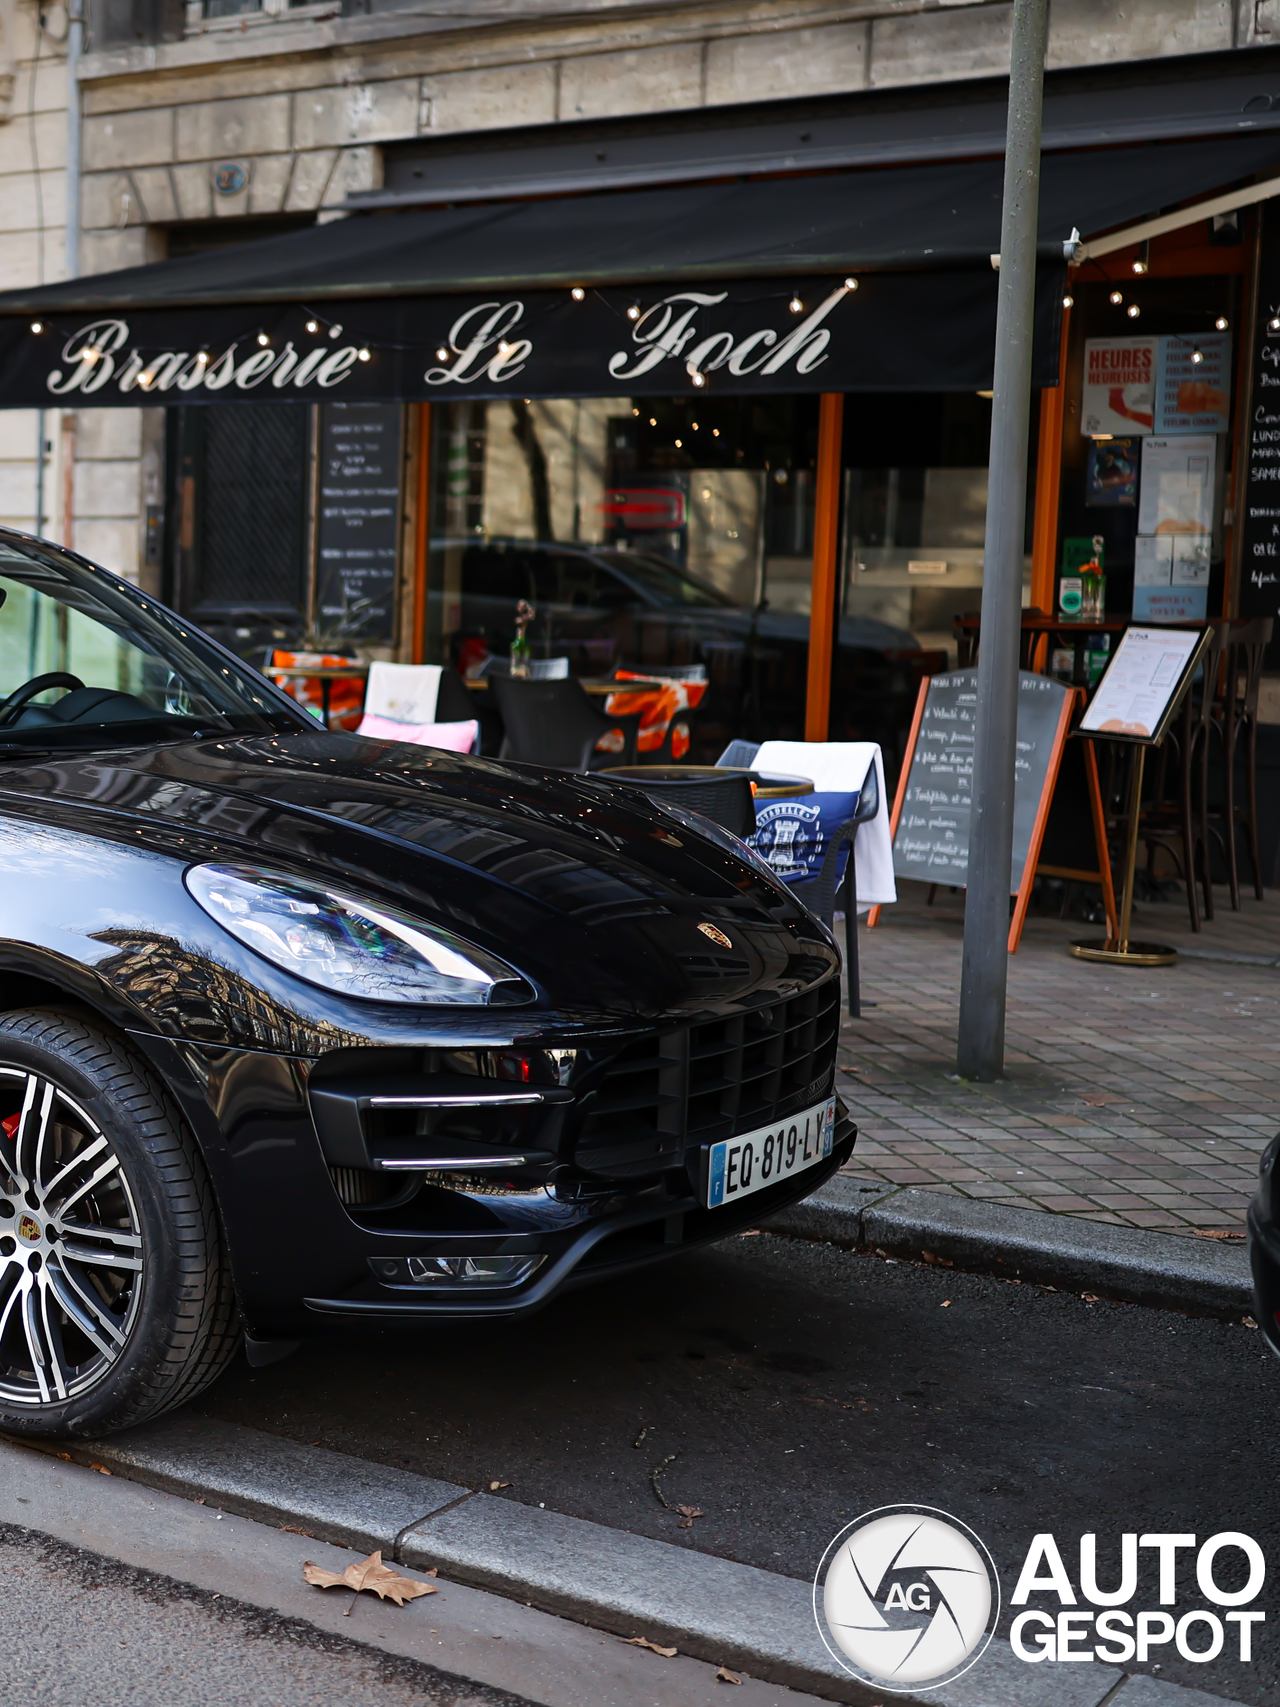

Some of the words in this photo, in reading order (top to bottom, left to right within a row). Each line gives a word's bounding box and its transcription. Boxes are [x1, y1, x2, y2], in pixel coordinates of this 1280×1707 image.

[46, 319, 358, 395] Brasserie
[424, 300, 534, 387] Le
[607, 287, 850, 381] Foch
[1089, 348, 1152, 369] HEURES
[1088, 370, 1151, 385] HEUREUSES
[824, 1130, 833, 1151] 91
[726, 1110, 825, 1195] EQ-819-LY
[714, 1181, 720, 1195] F
